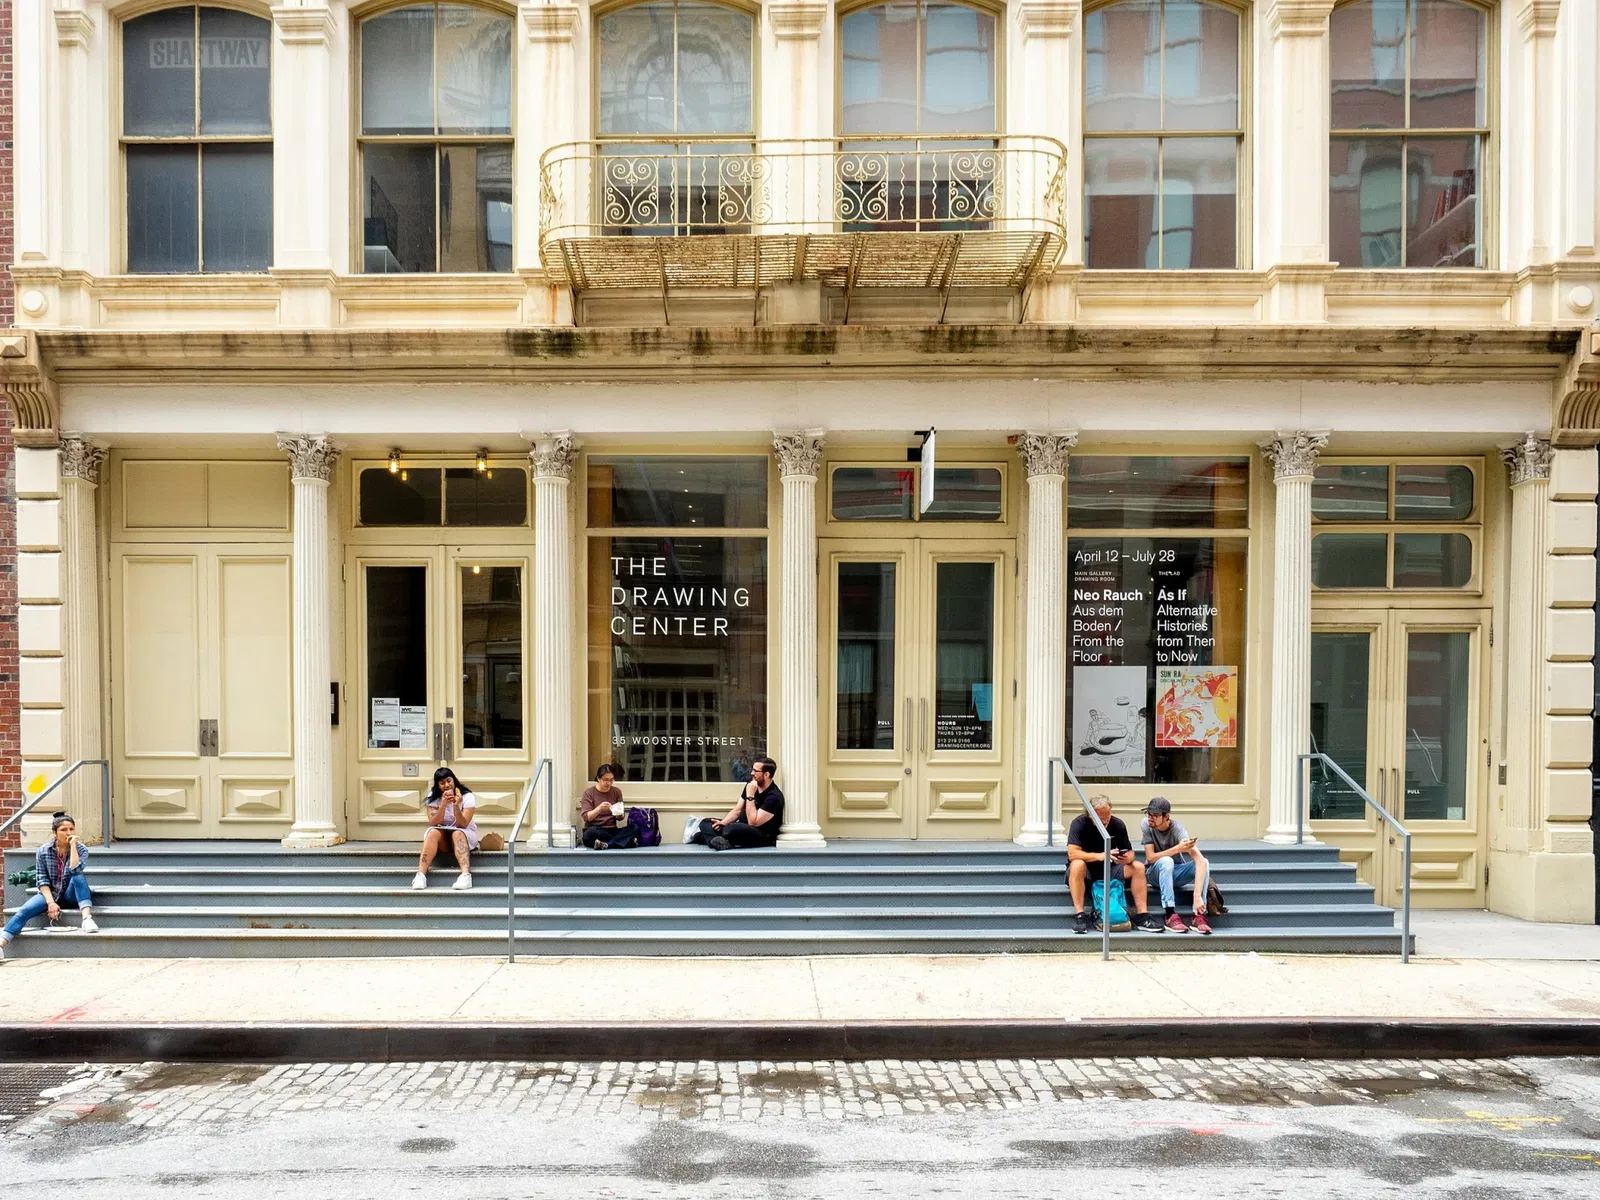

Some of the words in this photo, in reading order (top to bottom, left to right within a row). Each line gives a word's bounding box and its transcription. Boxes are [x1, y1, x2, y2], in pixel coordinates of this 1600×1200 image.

[1074, 550, 1101, 565] April
[1105, 550, 1119, 562] 12
[1132, 550, 1156, 565] July
[1159, 550, 1175, 562] 28
[611, 557, 666, 576] THE
[611, 587, 749, 606] DRAWING
[1074, 589, 1099, 601] Neo
[1103, 589, 1143, 601] Rauch
[1157, 589, 1174, 601] As
[1178, 589, 1187, 601] If
[1073, 605, 1095, 616] Aus
[1098, 604, 1124, 616] dem
[1156, 604, 1218, 616] Alternative
[610, 616, 728, 636] CENTER
[1073, 620, 1112, 632] Boden
[1157, 620, 1208, 631] Histories
[1073, 635, 1102, 647] From
[1105, 635, 1124, 647] the
[1156, 635, 1183, 647] from
[1186, 635, 1215, 647] Then
[1073, 650, 1102, 662] Floor
[1156, 651, 1168, 662] to
[1171, 651, 1198, 662] Now
[1160, 670, 1171, 678] SUN
[1173, 670, 1181, 678] RA
[612, 736, 626, 746] 35
[632, 736, 691, 745] WOOSTER
[697, 737, 744, 746] STREET
